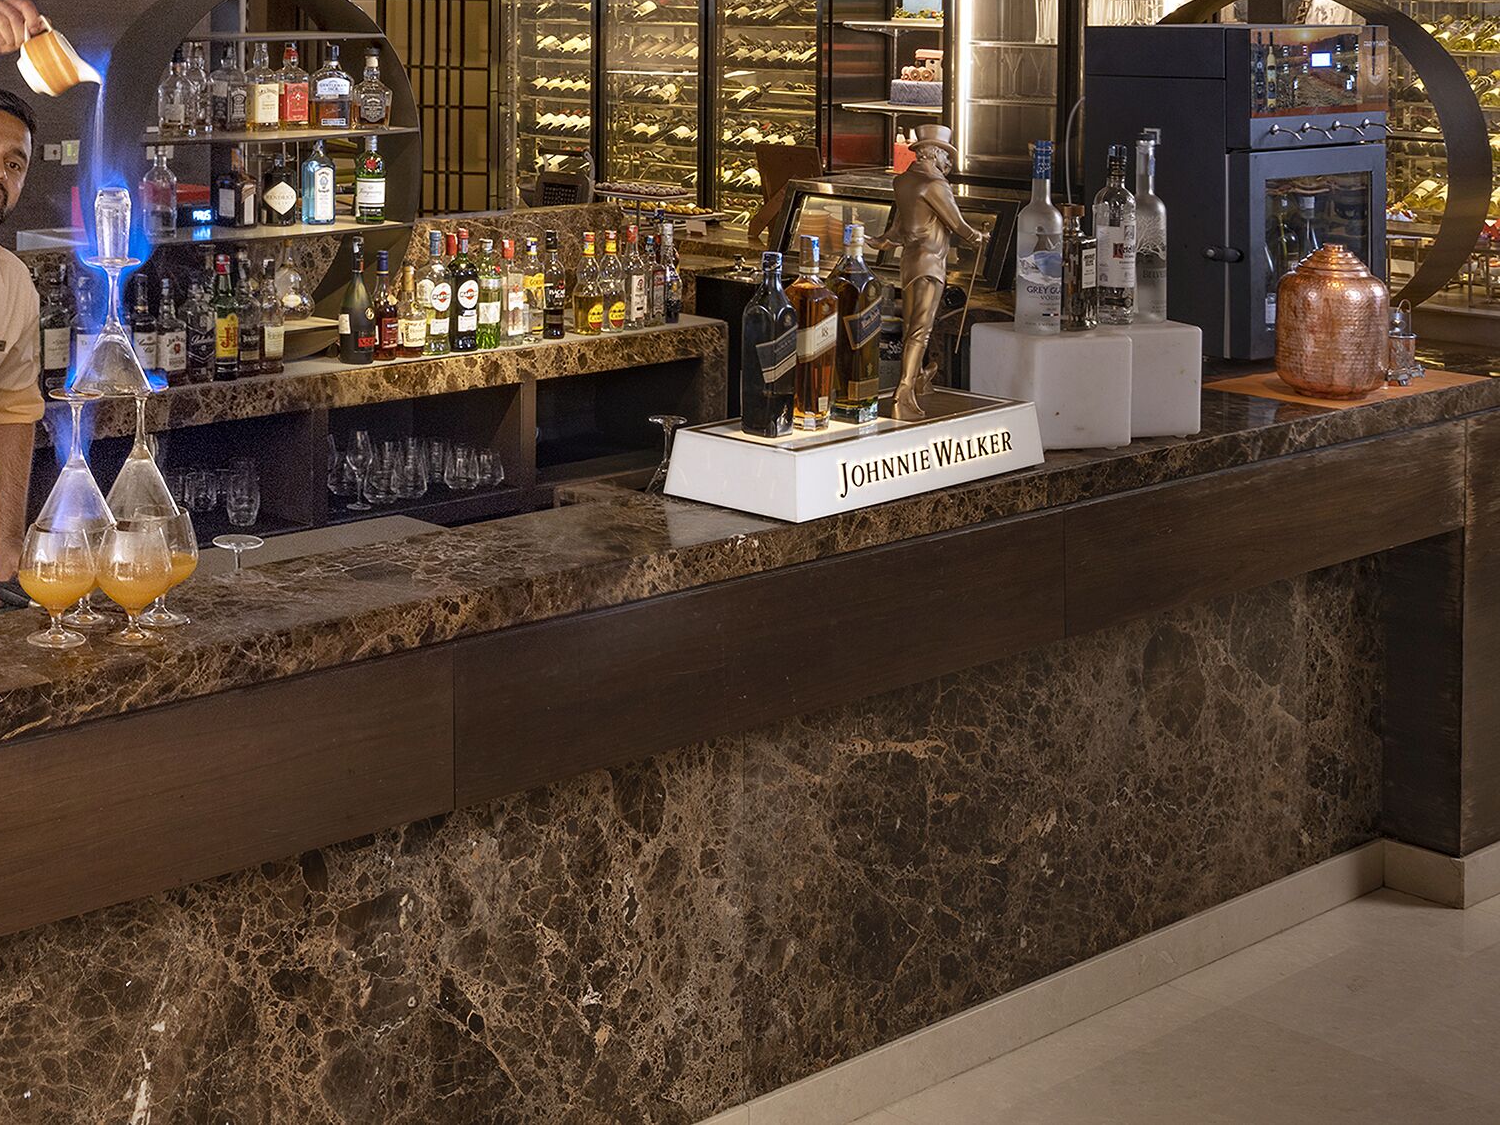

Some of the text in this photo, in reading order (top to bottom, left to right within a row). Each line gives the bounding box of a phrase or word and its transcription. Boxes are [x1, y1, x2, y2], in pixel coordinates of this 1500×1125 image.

[1026, 285, 1049, 295] GREY
[840, 431, 1013, 498] JOHNNIE WALKER
